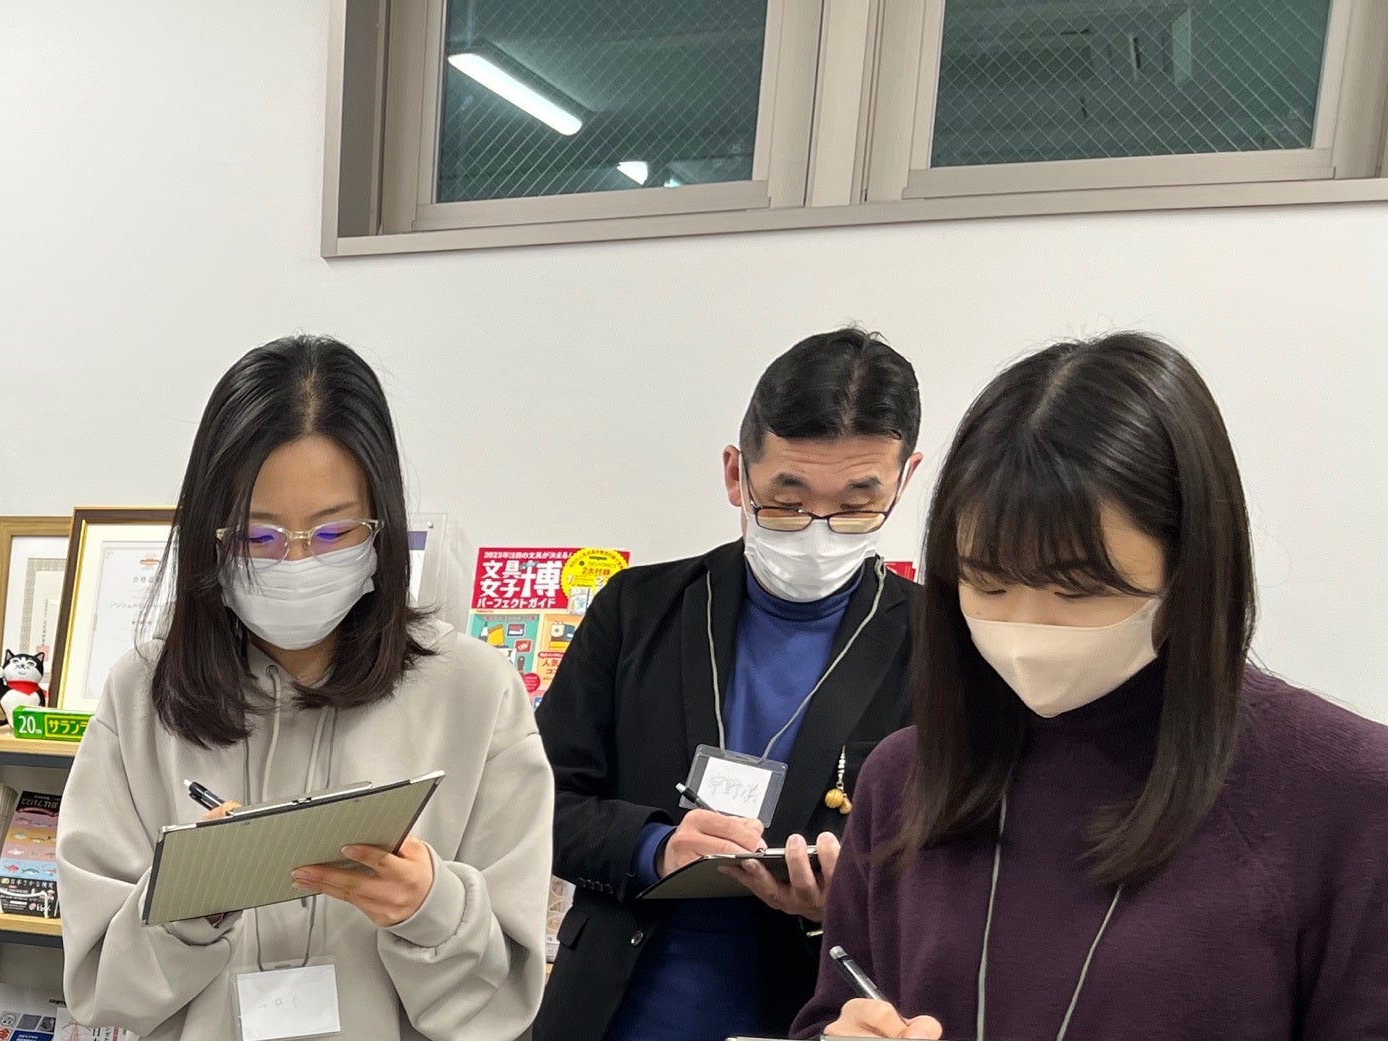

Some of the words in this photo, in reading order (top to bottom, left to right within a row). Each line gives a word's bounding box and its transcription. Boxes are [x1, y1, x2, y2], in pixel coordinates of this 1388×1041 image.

[482, 560, 521, 579] 文具
[479, 579, 520, 598] 女子
[476, 597, 556, 609] パーフェクトガイド
